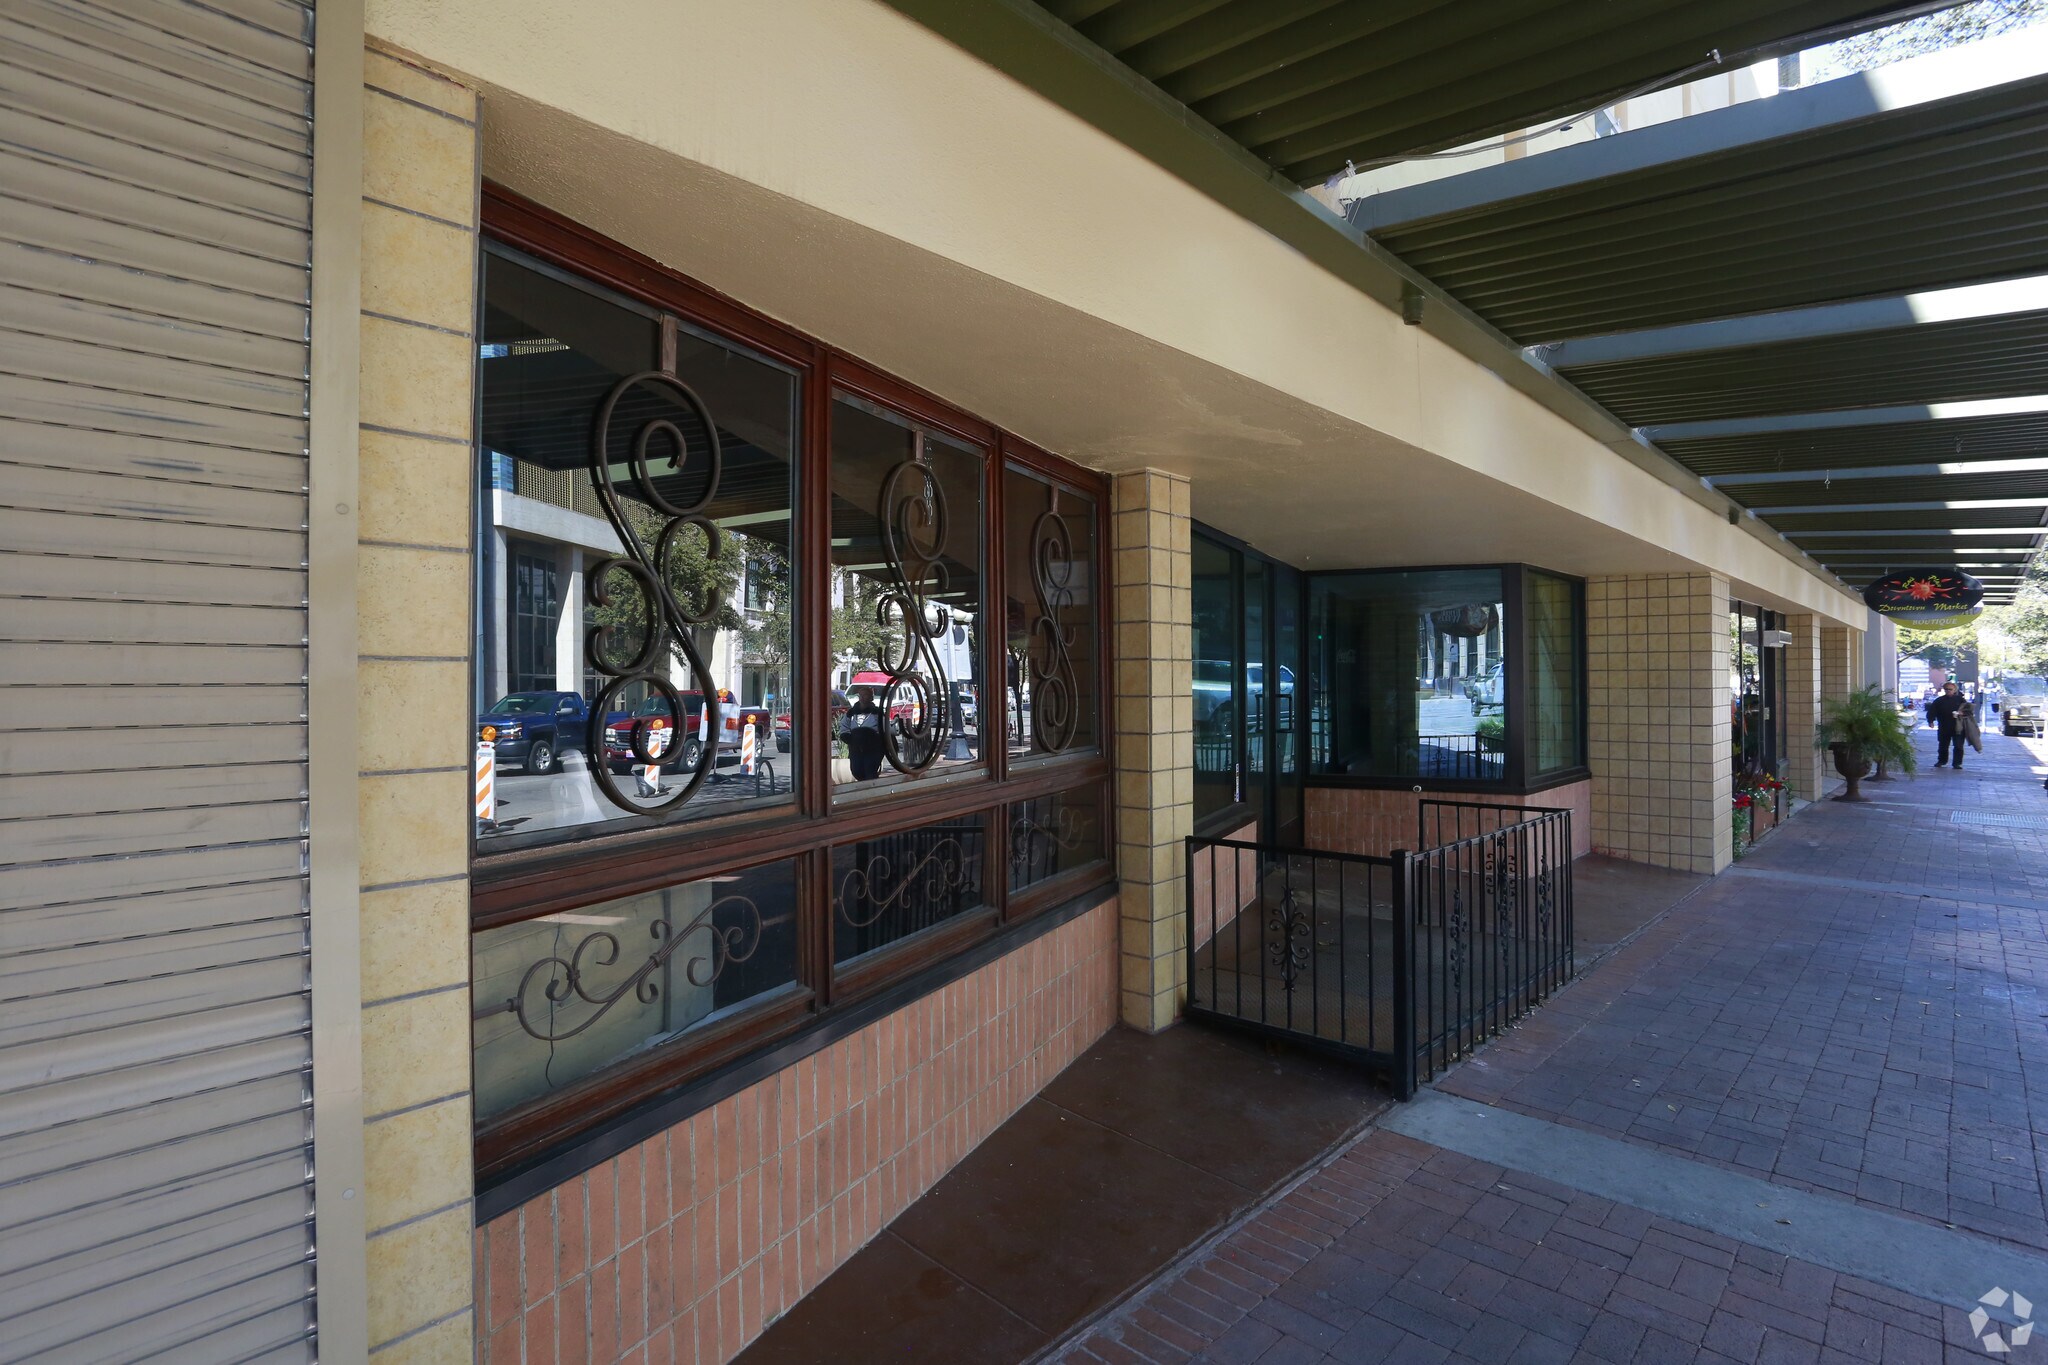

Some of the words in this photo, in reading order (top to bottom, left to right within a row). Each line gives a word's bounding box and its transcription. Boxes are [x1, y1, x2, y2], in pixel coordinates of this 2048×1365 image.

[1879, 604, 1926, 612] Downtown
[1933, 602, 1968, 611] Market
[1912, 618, 1957, 626] BOUTIQUE
